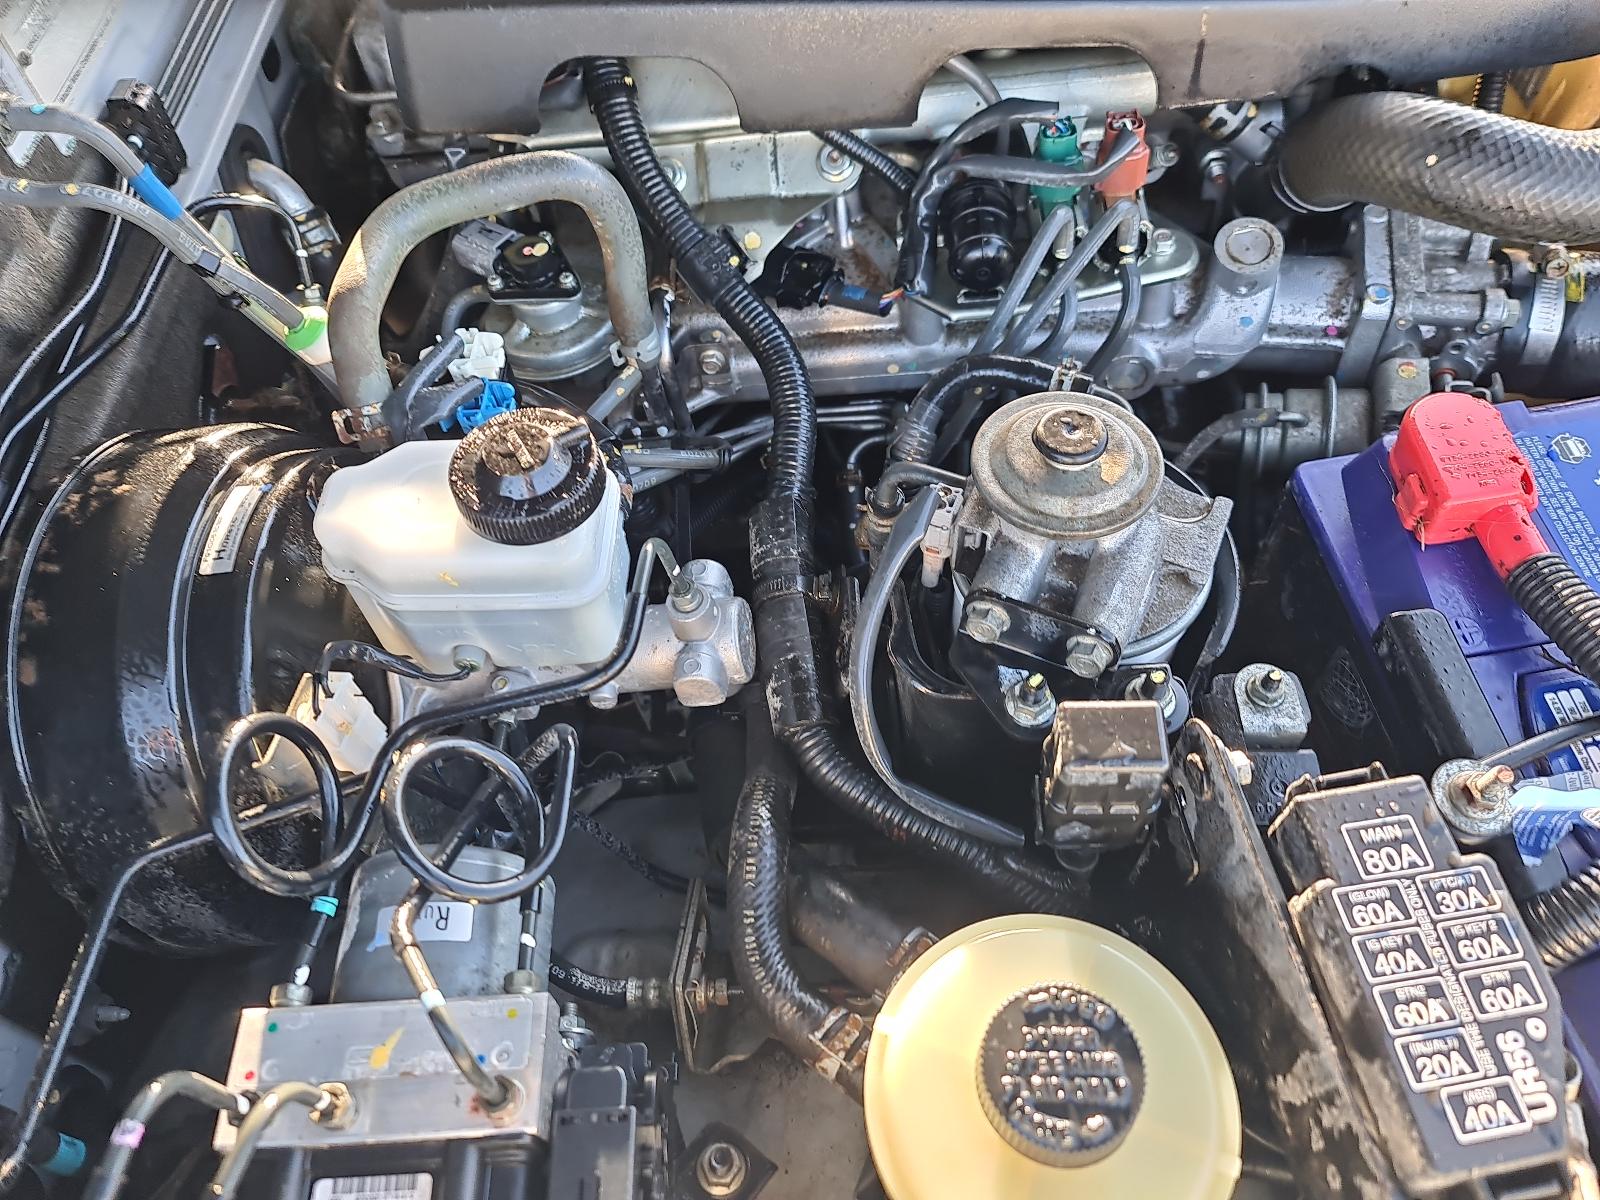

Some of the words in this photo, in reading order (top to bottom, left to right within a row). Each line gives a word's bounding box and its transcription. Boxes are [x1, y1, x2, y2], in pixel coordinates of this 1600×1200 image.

[1536, 460, 1560, 492] COLLECTION
[1556, 508, 1575, 533] WEBSITE
[1576, 511, 1596, 535] BATTERY
[1360, 824, 1402, 844] MAIN
[1363, 844, 1425, 874] 80A
[1349, 887, 1390, 904] (GLOW)
[1400, 879, 1423, 908] ONLY
[1435, 886, 1490, 913] 30A
[419, 904, 450, 930] Ru
[1352, 900, 1405, 926] 60A
[1414, 908, 1440, 946] FUSES
[1375, 948, 1427, 975] 40A
[1458, 934, 1512, 960] 60A
[1432, 946, 1475, 1023] DESIGNATED
[1480, 983, 1536, 1013] 60A
[1394, 998, 1450, 1027] 60A
[1464, 1022, 1486, 1049] THE
[1416, 1050, 1473, 1082] 20A
[1476, 1048, 1498, 1077] USE
[1495, 1030, 1558, 1125] UR56
[1464, 1099, 1522, 1131] 40A
